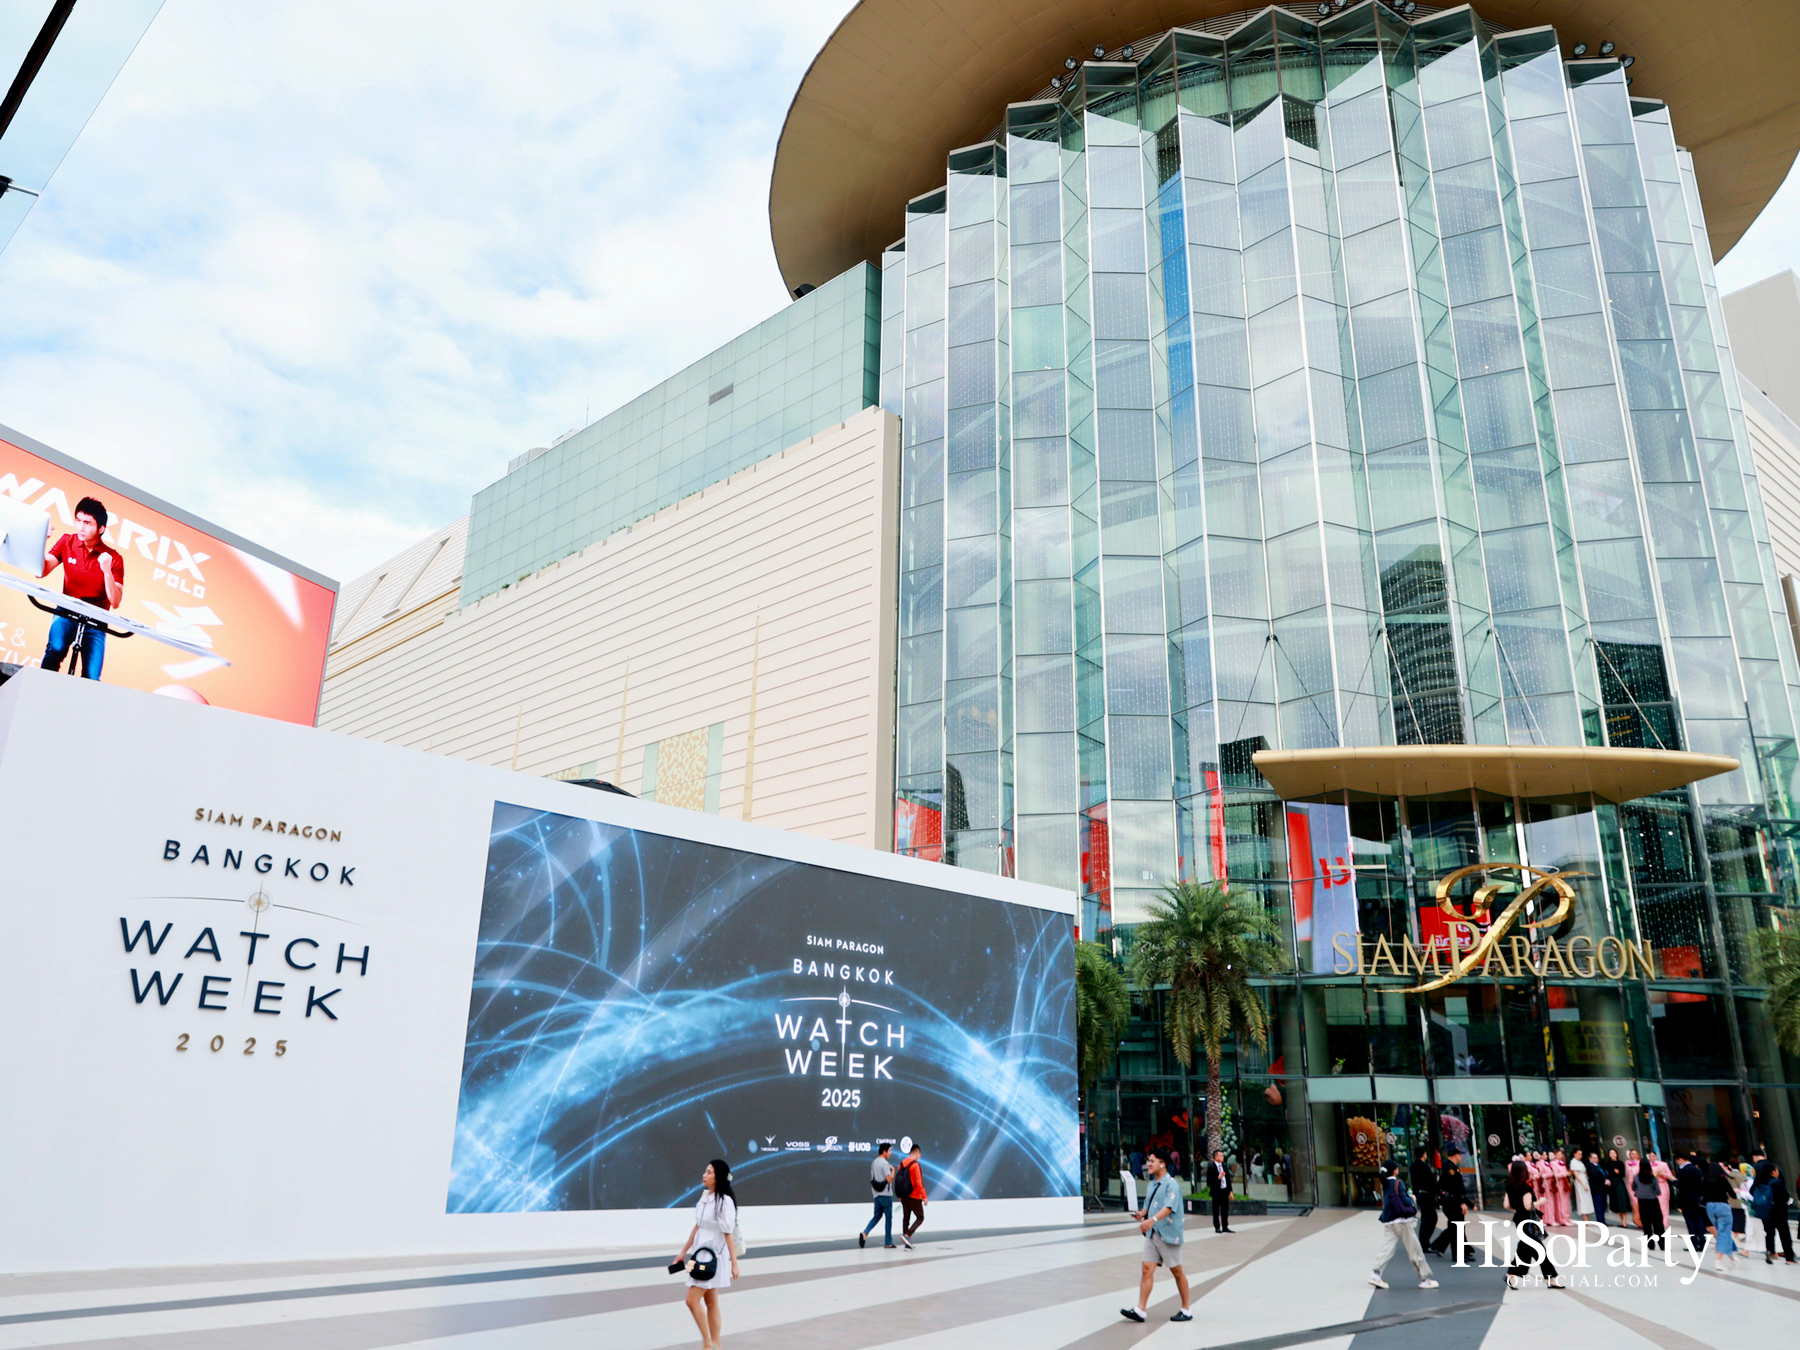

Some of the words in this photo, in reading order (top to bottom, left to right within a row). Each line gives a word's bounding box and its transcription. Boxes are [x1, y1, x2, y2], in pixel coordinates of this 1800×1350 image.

[152, 567, 206, 600] POLO
[194, 807, 243, 828] SIAM
[252, 816, 342, 843] PARAGON
[162, 839, 357, 887] BANGKOK
[119, 916, 370, 977] WATCH
[806, 934, 833, 948] SIAM
[836, 938, 885, 955] PARAGON
[1331, 931, 1445, 978] SIAM
[1443, 920, 1657, 981] PARAGON
[792, 957, 895, 986] BANGKOK
[130, 968, 343, 1020] WEEK
[175, 1032, 288, 1057] 2025
[774, 1013, 905, 1049] WATCH
[784, 1048, 894, 1081] WEEK
[820, 1087, 862, 1109] 2025
[855, 1142, 871, 1152] UOB
